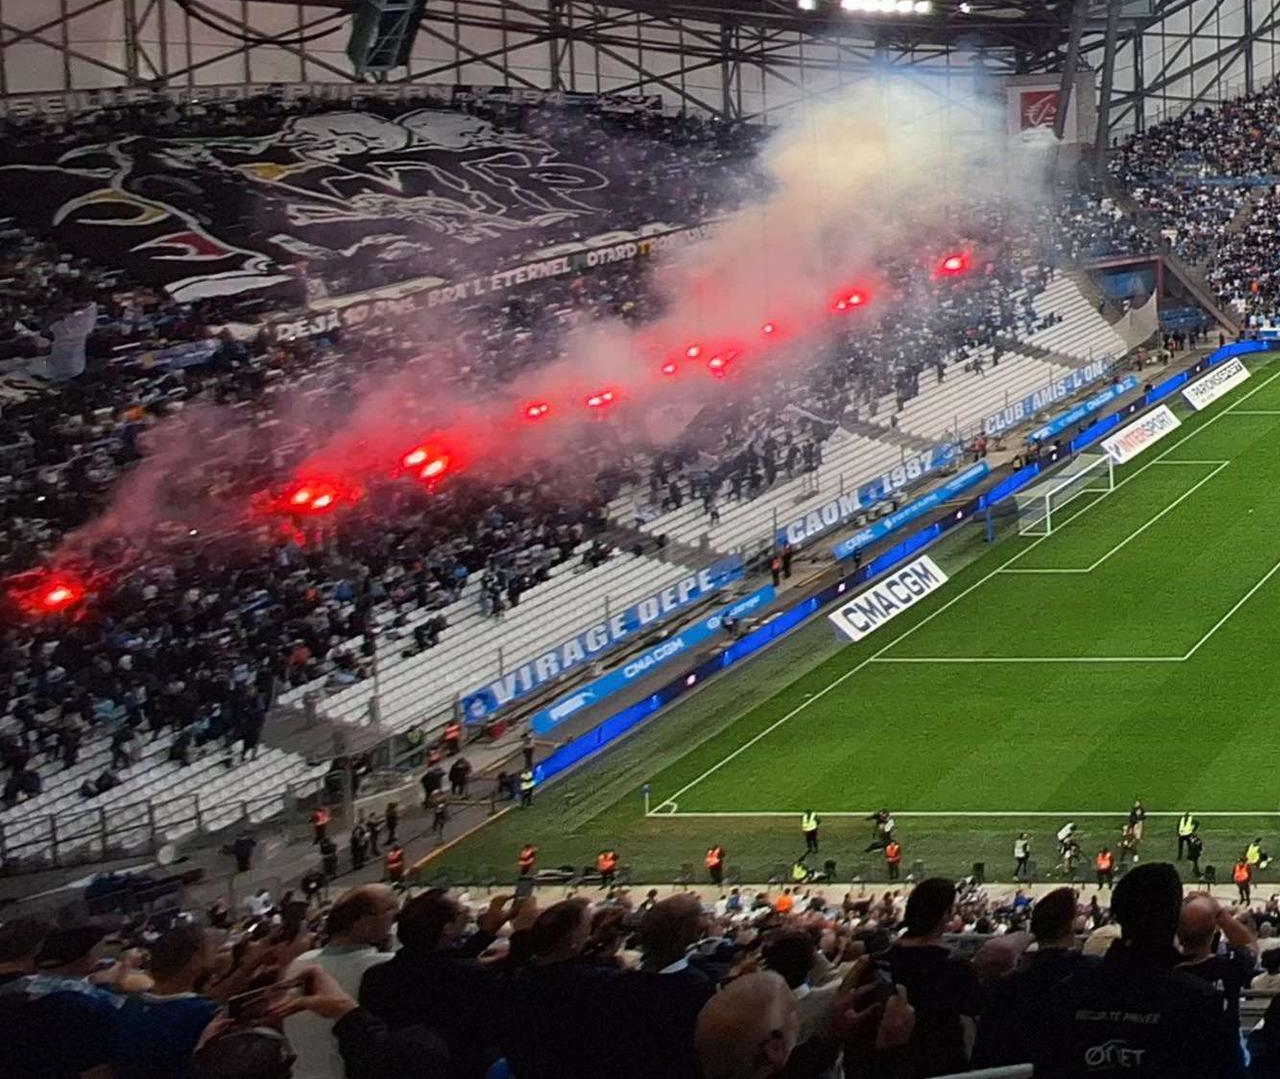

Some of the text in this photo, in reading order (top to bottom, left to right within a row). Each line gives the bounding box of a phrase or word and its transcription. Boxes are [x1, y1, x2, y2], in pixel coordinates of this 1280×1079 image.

[984, 401, 1025, 436] CLUB
[1031, 379, 1068, 412] AMIS
[1118, 411, 1173, 454] INTERSPORT
[786, 489, 862, 545] CAOM
[881, 449, 934, 494] 1987
[490, 568, 715, 705] VIRAGE DEPE
